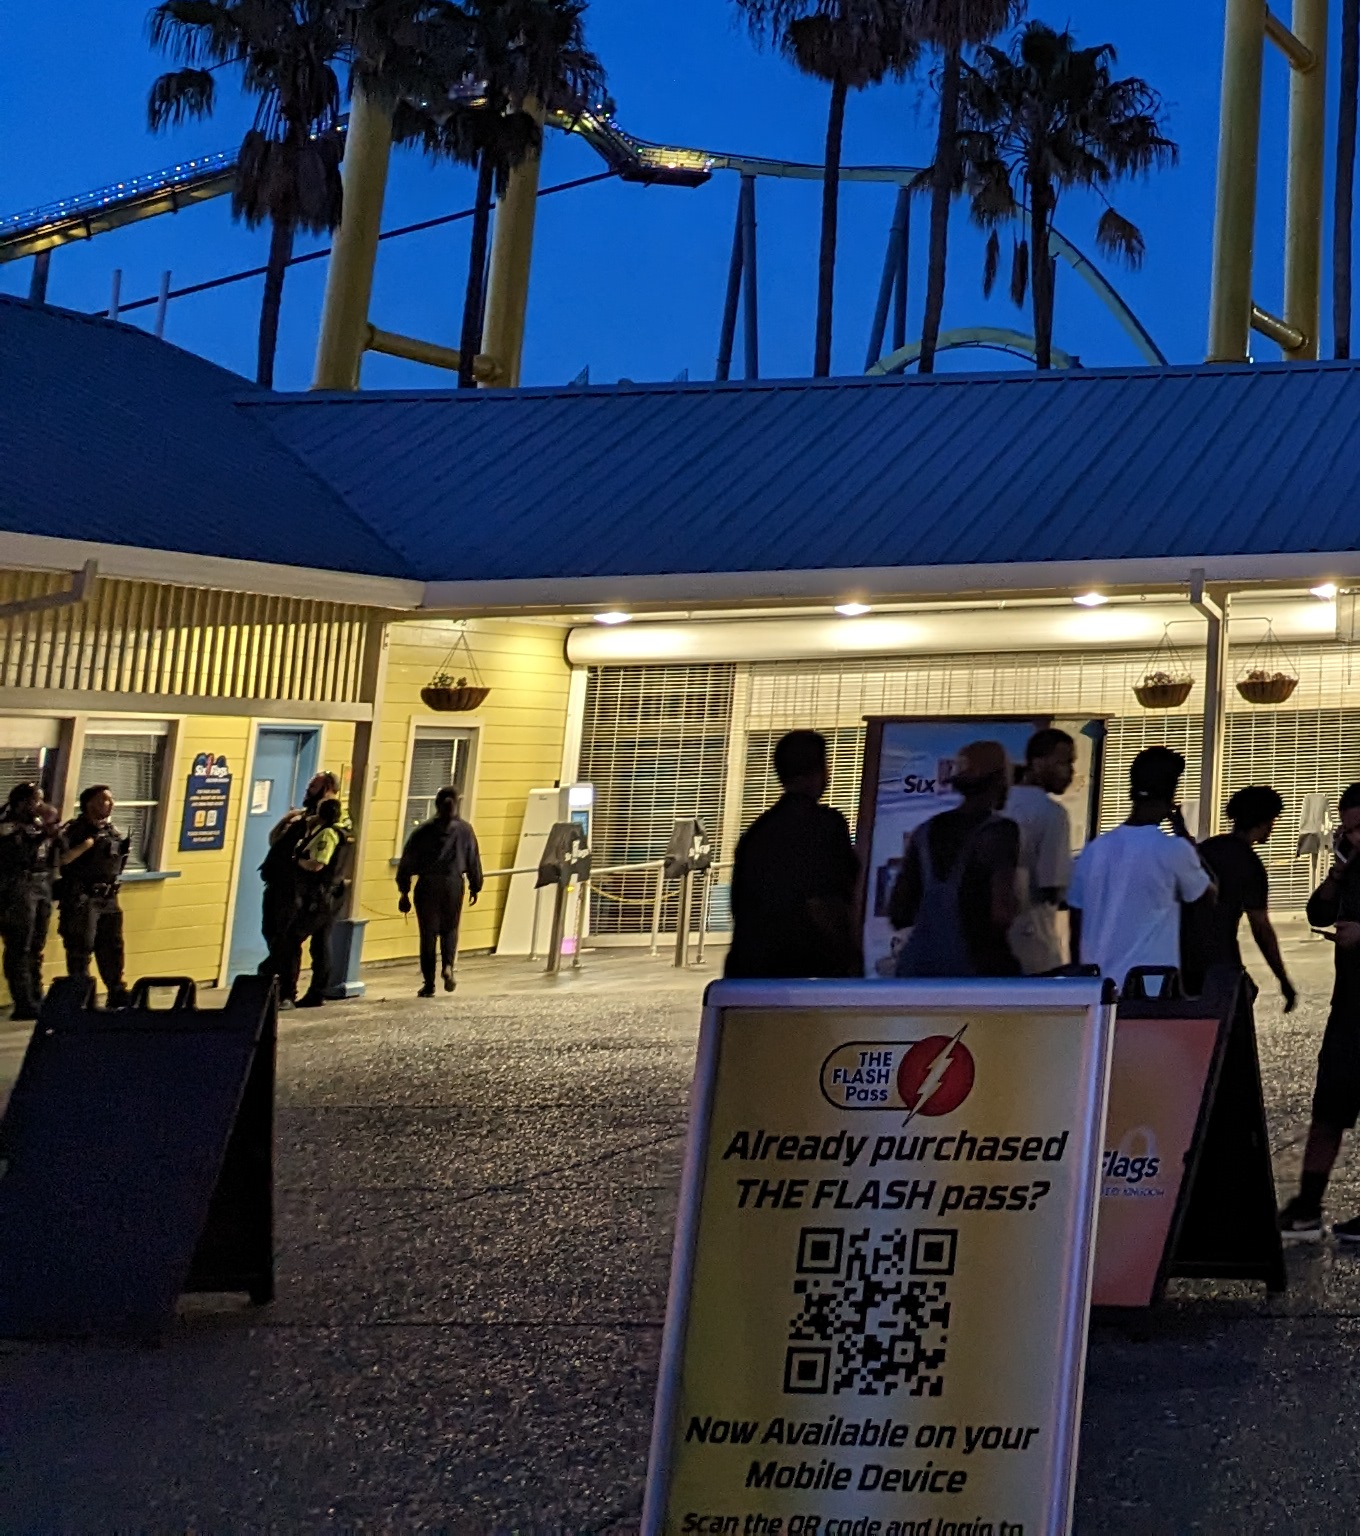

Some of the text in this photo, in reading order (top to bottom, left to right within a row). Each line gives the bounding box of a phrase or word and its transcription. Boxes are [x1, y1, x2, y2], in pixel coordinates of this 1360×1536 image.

[904, 775, 937, 794] Six
[860, 1051, 893, 1068] THE
[832, 1068, 890, 1084] FLASH
[845, 1086, 888, 1102] Pass
[722, 1130, 1069, 1166] Already purchased
[737, 1179, 1051, 1217] THE FLASH pass?
[685, 1415, 1040, 1455] Now Available on your
[745, 1459, 968, 1493] Mobile Device
[682, 1512, 740, 1536] Scan
[744, 1513, 783, 1536] the
[787, 1514, 818, 1536] QR
[825, 1516, 882, 1536] code
[888, 1517, 933, 1536] and
